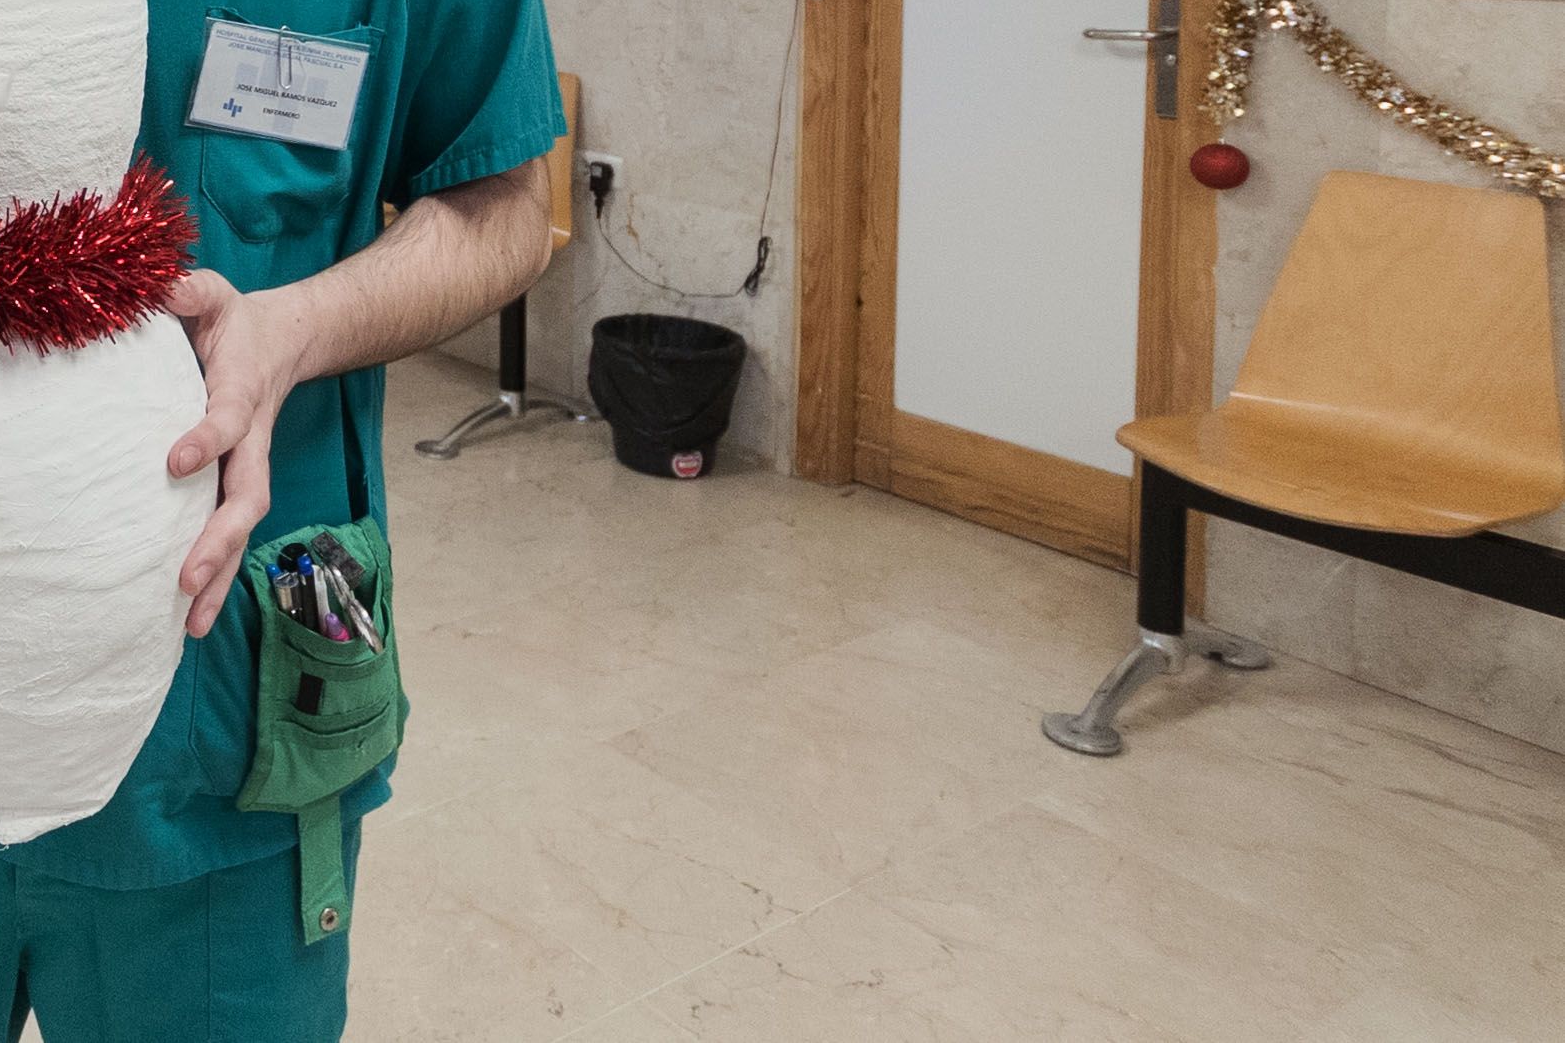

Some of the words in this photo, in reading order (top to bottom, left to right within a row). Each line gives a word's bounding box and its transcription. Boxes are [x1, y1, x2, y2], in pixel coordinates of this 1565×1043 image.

[236, 83, 253, 93] JOSE
[254, 86, 280, 98] MIGUEL
[281, 91, 306, 102] RAMOS
[307, 96, 338, 108] VAZQUEZ
[262, 107, 301, 119] ENFERMERO
